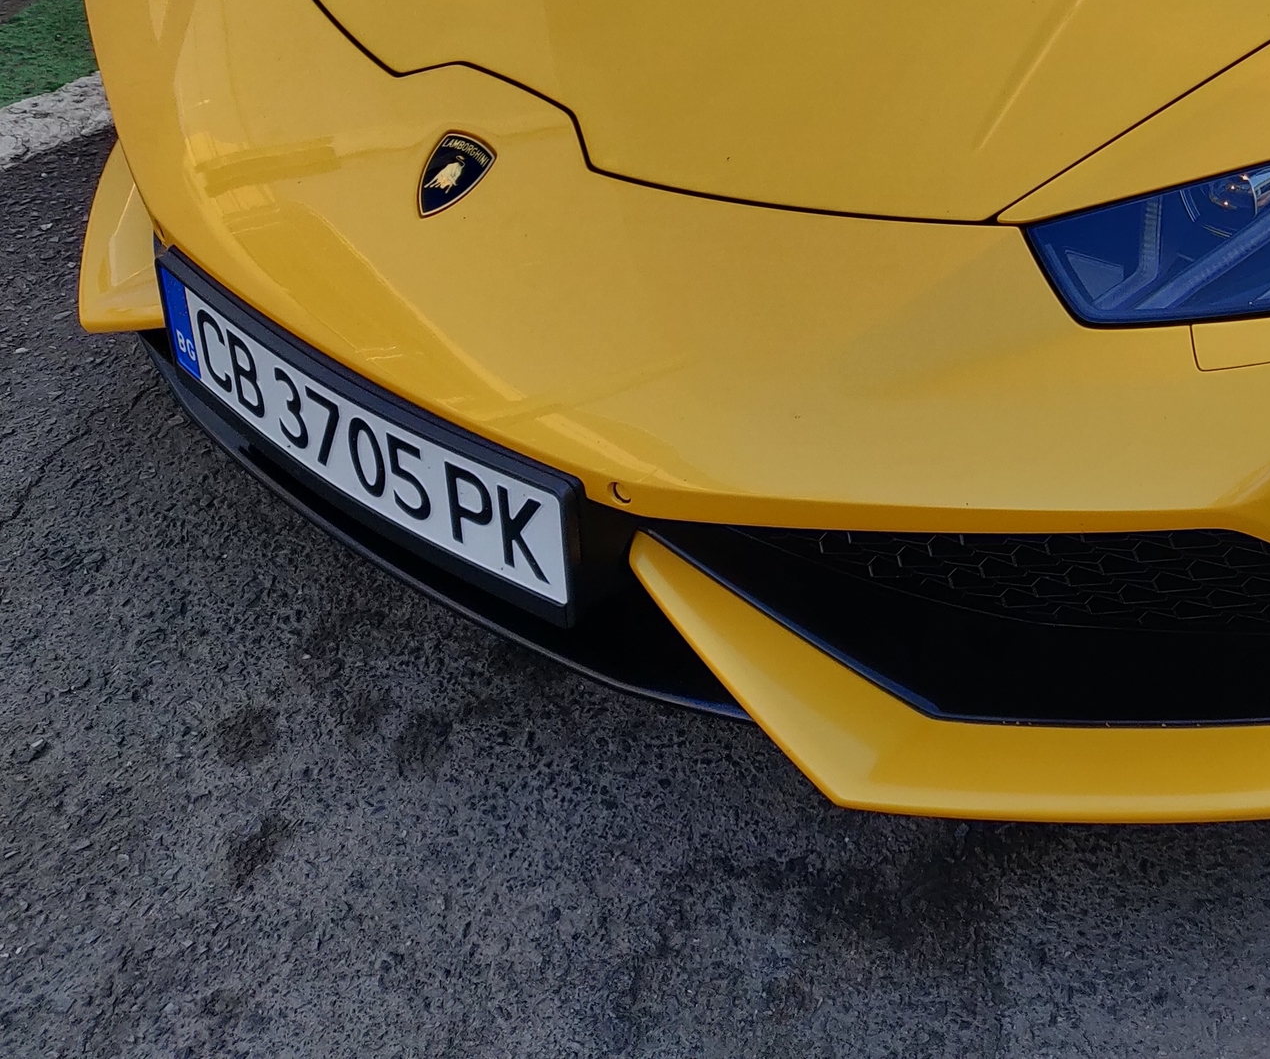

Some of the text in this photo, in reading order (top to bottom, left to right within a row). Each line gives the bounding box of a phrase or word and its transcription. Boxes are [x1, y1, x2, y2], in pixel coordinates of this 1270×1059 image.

[442, 138, 490, 168] LAMBORGHINI
[176, 329, 196, 361] BG
[197, 309, 550, 585] CB 3705 PK
